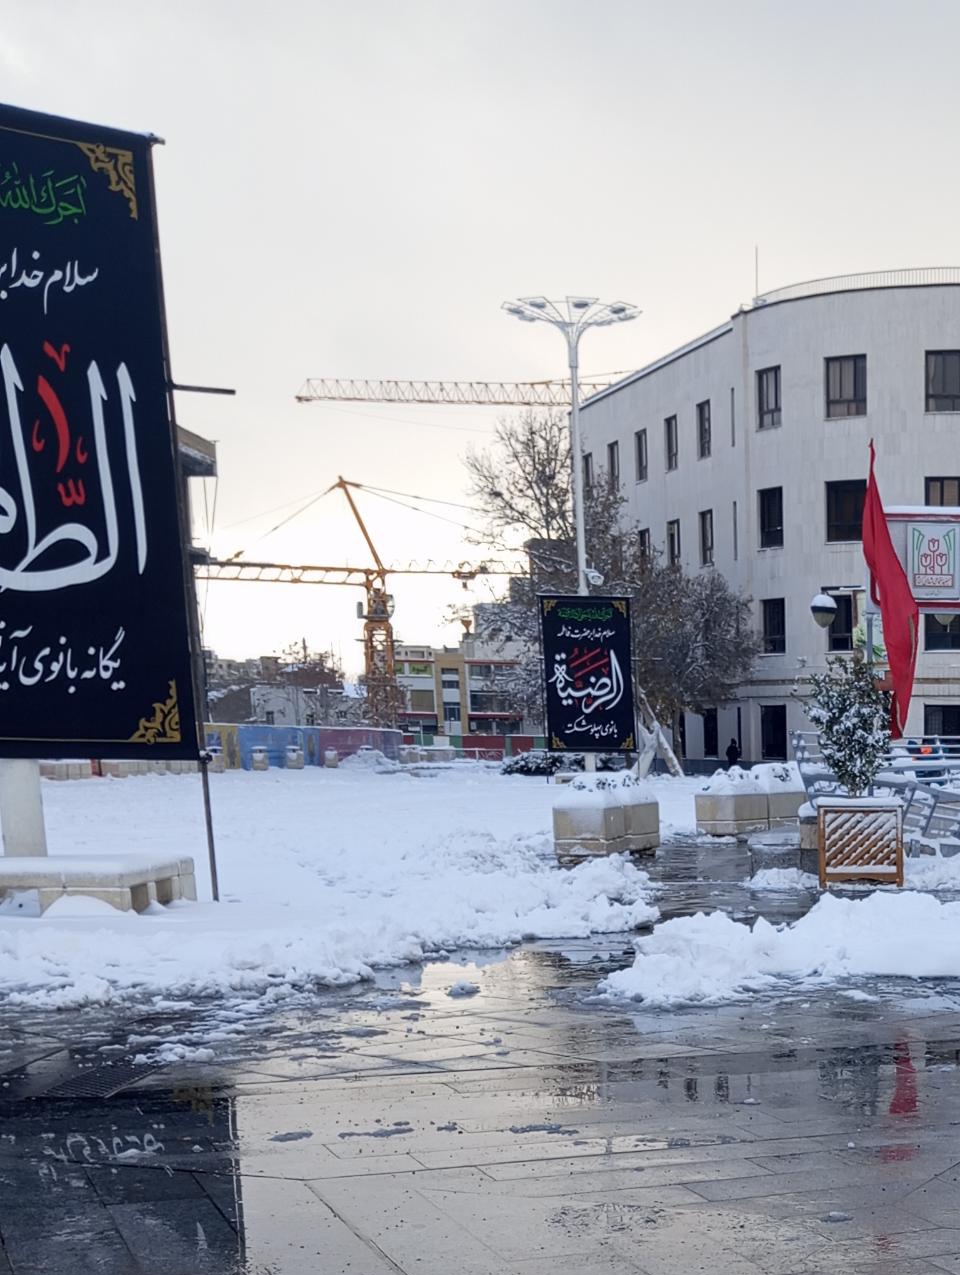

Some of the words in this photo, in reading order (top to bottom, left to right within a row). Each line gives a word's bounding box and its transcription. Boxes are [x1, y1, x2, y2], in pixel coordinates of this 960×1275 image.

[8, 247, 45, 289] خدا
[43, 259, 99, 315] سلام
[570, 627, 591, 641] حضرت
[592, 627, 602, 639] خدا
[600, 628, 616, 643] سلام
[18, 635, 78, 694] بانوی
[80, 626, 126, 691] یگانه
[589, 722, 602, 740] پهلو
[600, 720, 618, 739] بانوی
